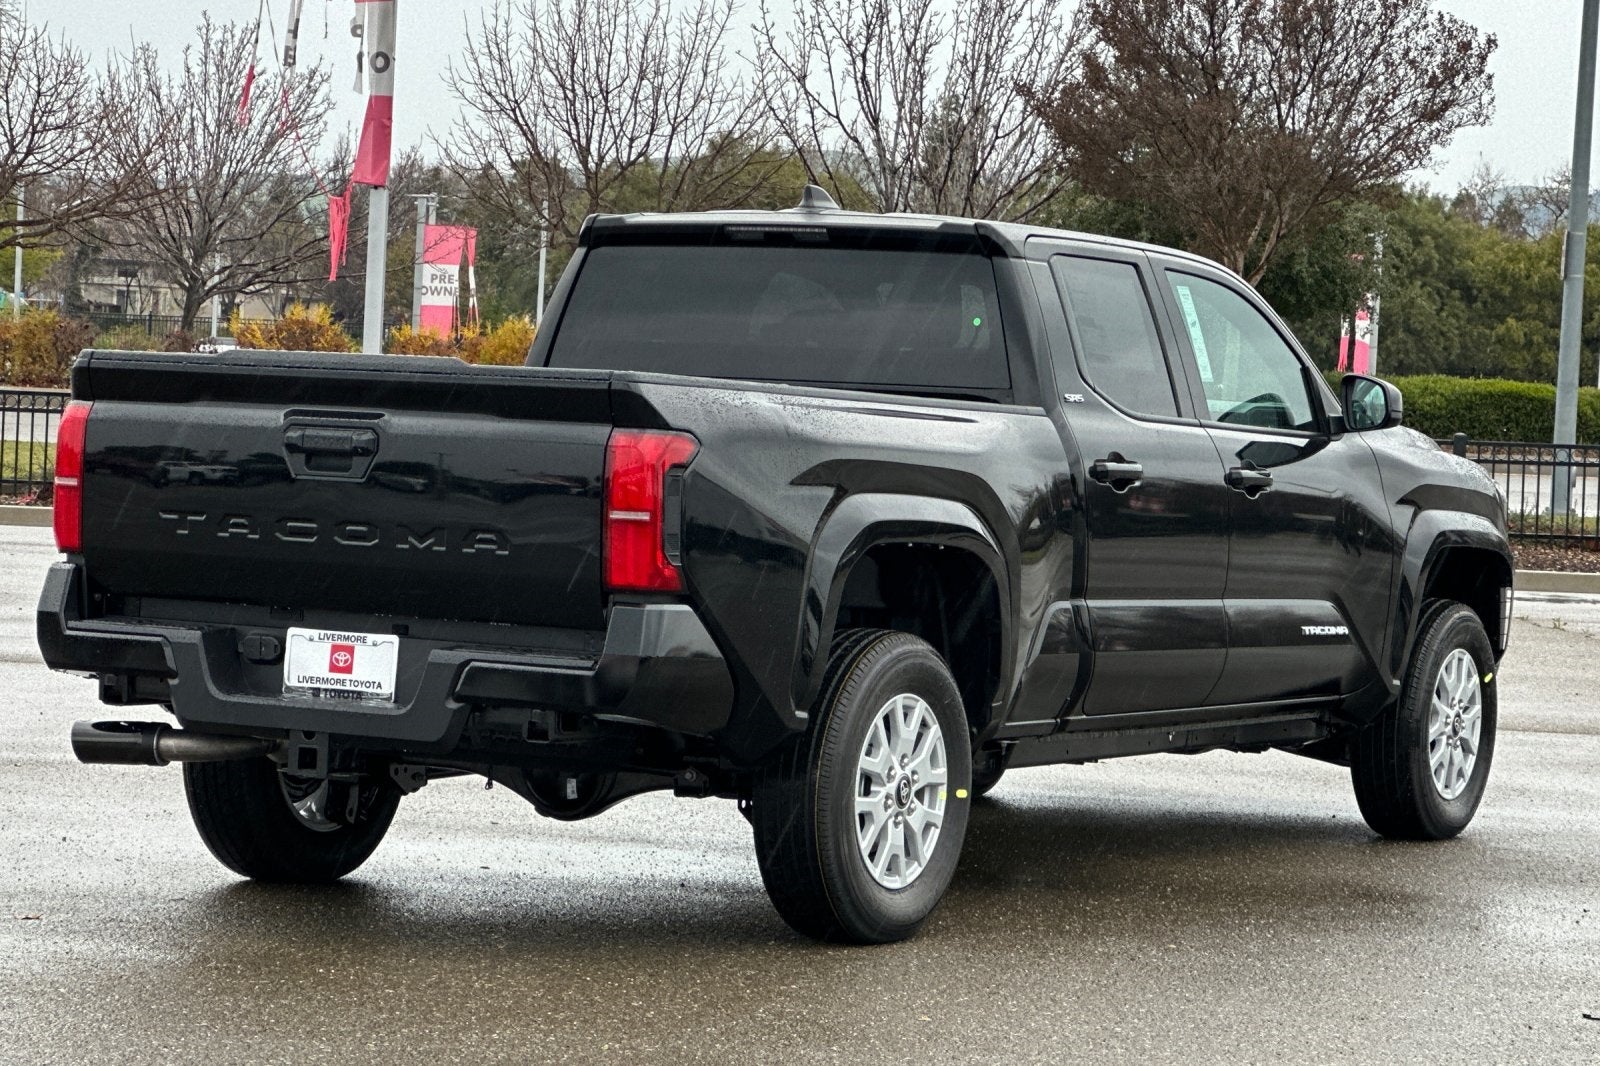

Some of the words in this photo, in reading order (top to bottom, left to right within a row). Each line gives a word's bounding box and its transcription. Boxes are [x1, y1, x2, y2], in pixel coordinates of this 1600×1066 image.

[430, 273, 458, 284] PRE-
[158, 510, 509, 555] TACOMA
[1301, 626, 1349, 635] TACOMA
[318, 633, 368, 644] LIVERMORE
[297, 675, 347, 687] LIVERMORE
[349, 679, 383, 690] TOYOTA
